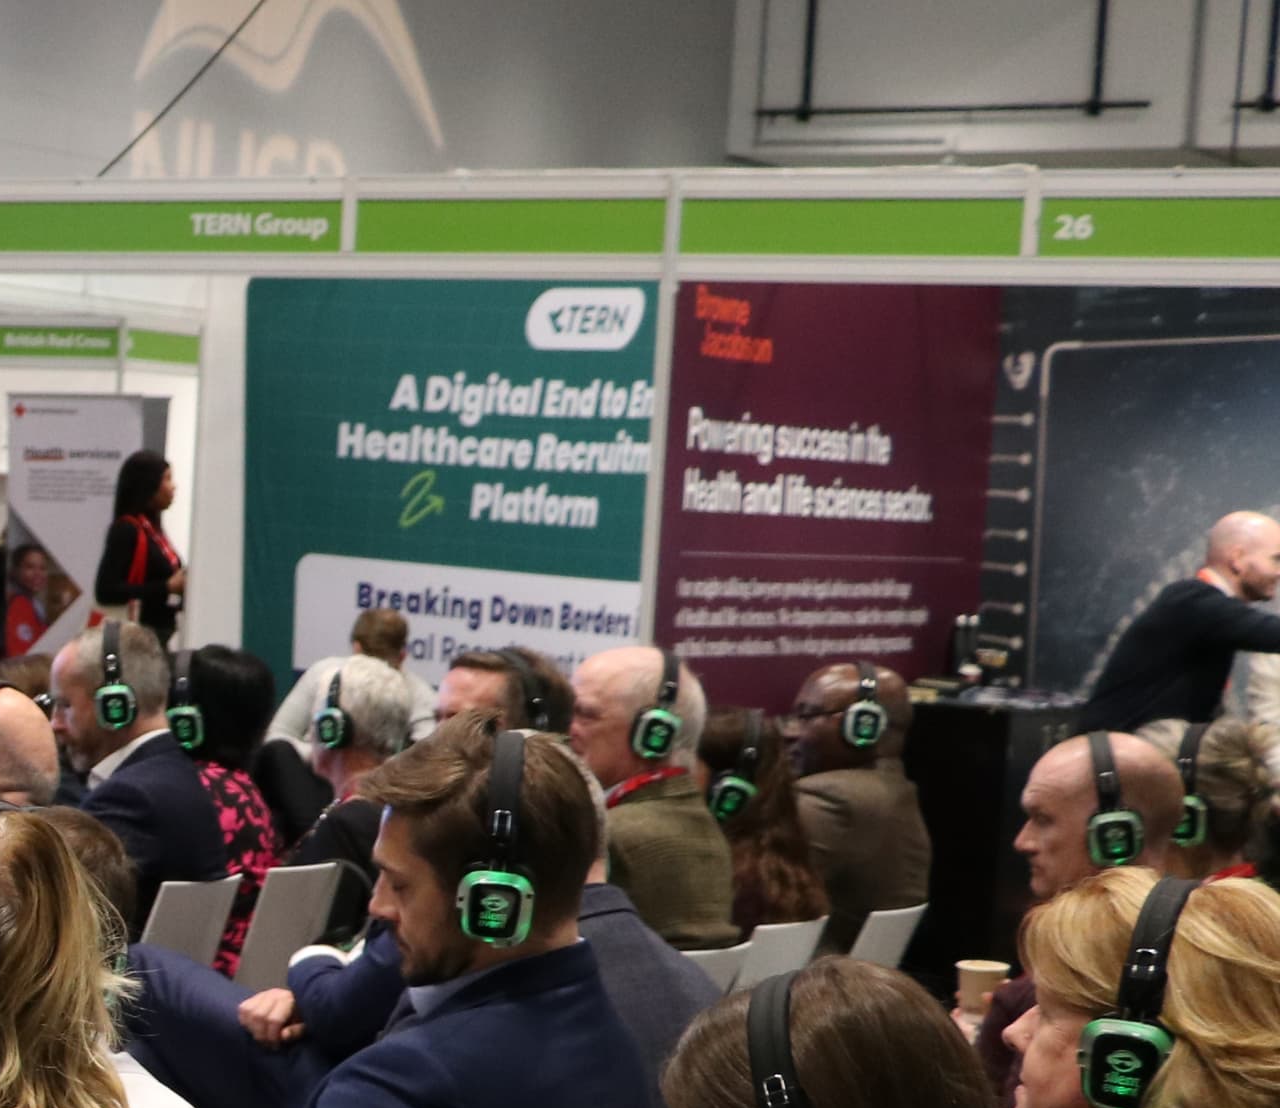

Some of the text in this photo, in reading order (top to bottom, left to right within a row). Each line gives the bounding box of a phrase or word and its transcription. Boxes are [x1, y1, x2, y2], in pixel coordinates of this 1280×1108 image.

[190, 212, 253, 237] TERN
[255, 213, 328, 240] Group
[1053, 214, 1095, 240] 26
[565, 305, 630, 335] TERN
[389, 373, 419, 410] A
[423, 371, 542, 427] Digital
[542, 378, 600, 418] End
[600, 380, 629, 419] to
[337, 421, 533, 471] Healthcare
[687, 405, 773, 465] Powering
[775, 425, 848, 463] success
[469, 481, 599, 528] Platform
[682, 467, 741, 514] Health
[742, 473, 783, 516] and
[784, 473, 814, 517] life
[814, 477, 883, 521] sciences
[357, 581, 482, 631] Breaking
[489, 595, 554, 629] Down
[560, 602, 631, 638] Borders
